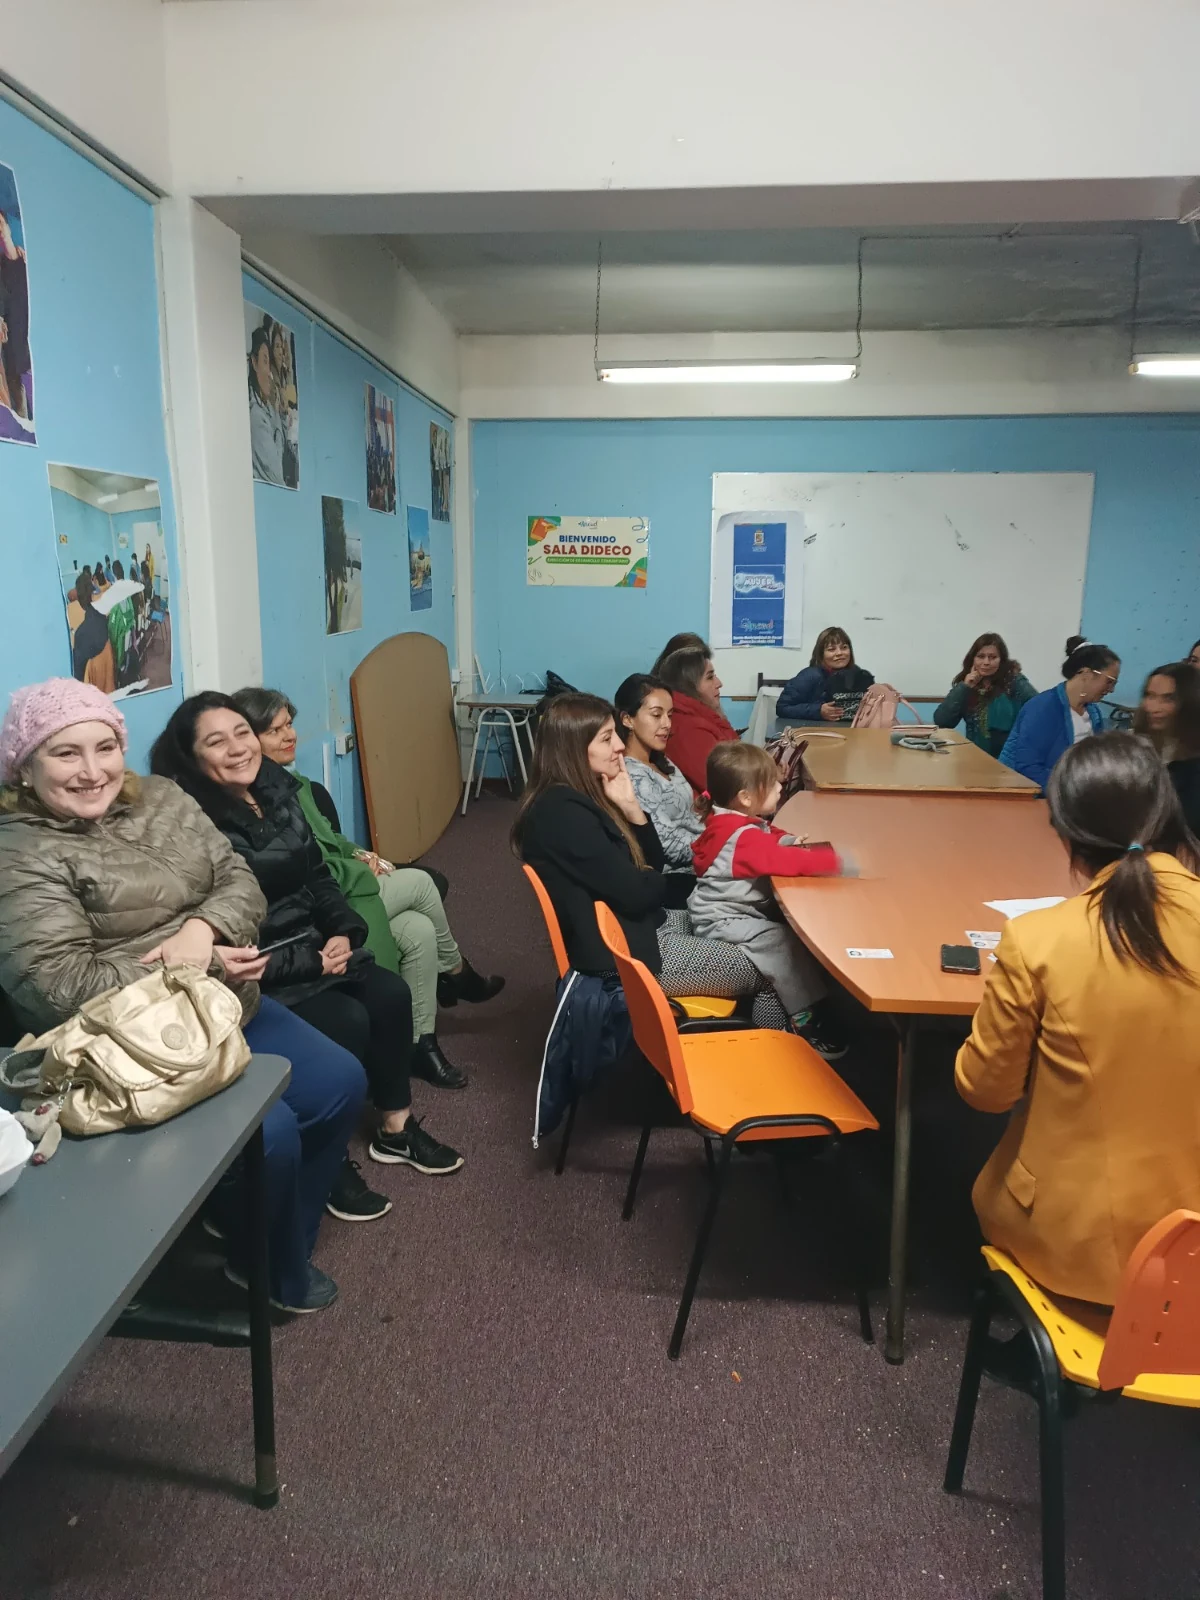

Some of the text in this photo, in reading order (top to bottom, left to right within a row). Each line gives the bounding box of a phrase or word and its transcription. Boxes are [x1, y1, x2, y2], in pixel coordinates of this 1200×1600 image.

[559, 535, 616, 543] BIENVENIDO
[543, 544, 632, 556] SALA DIDECO
